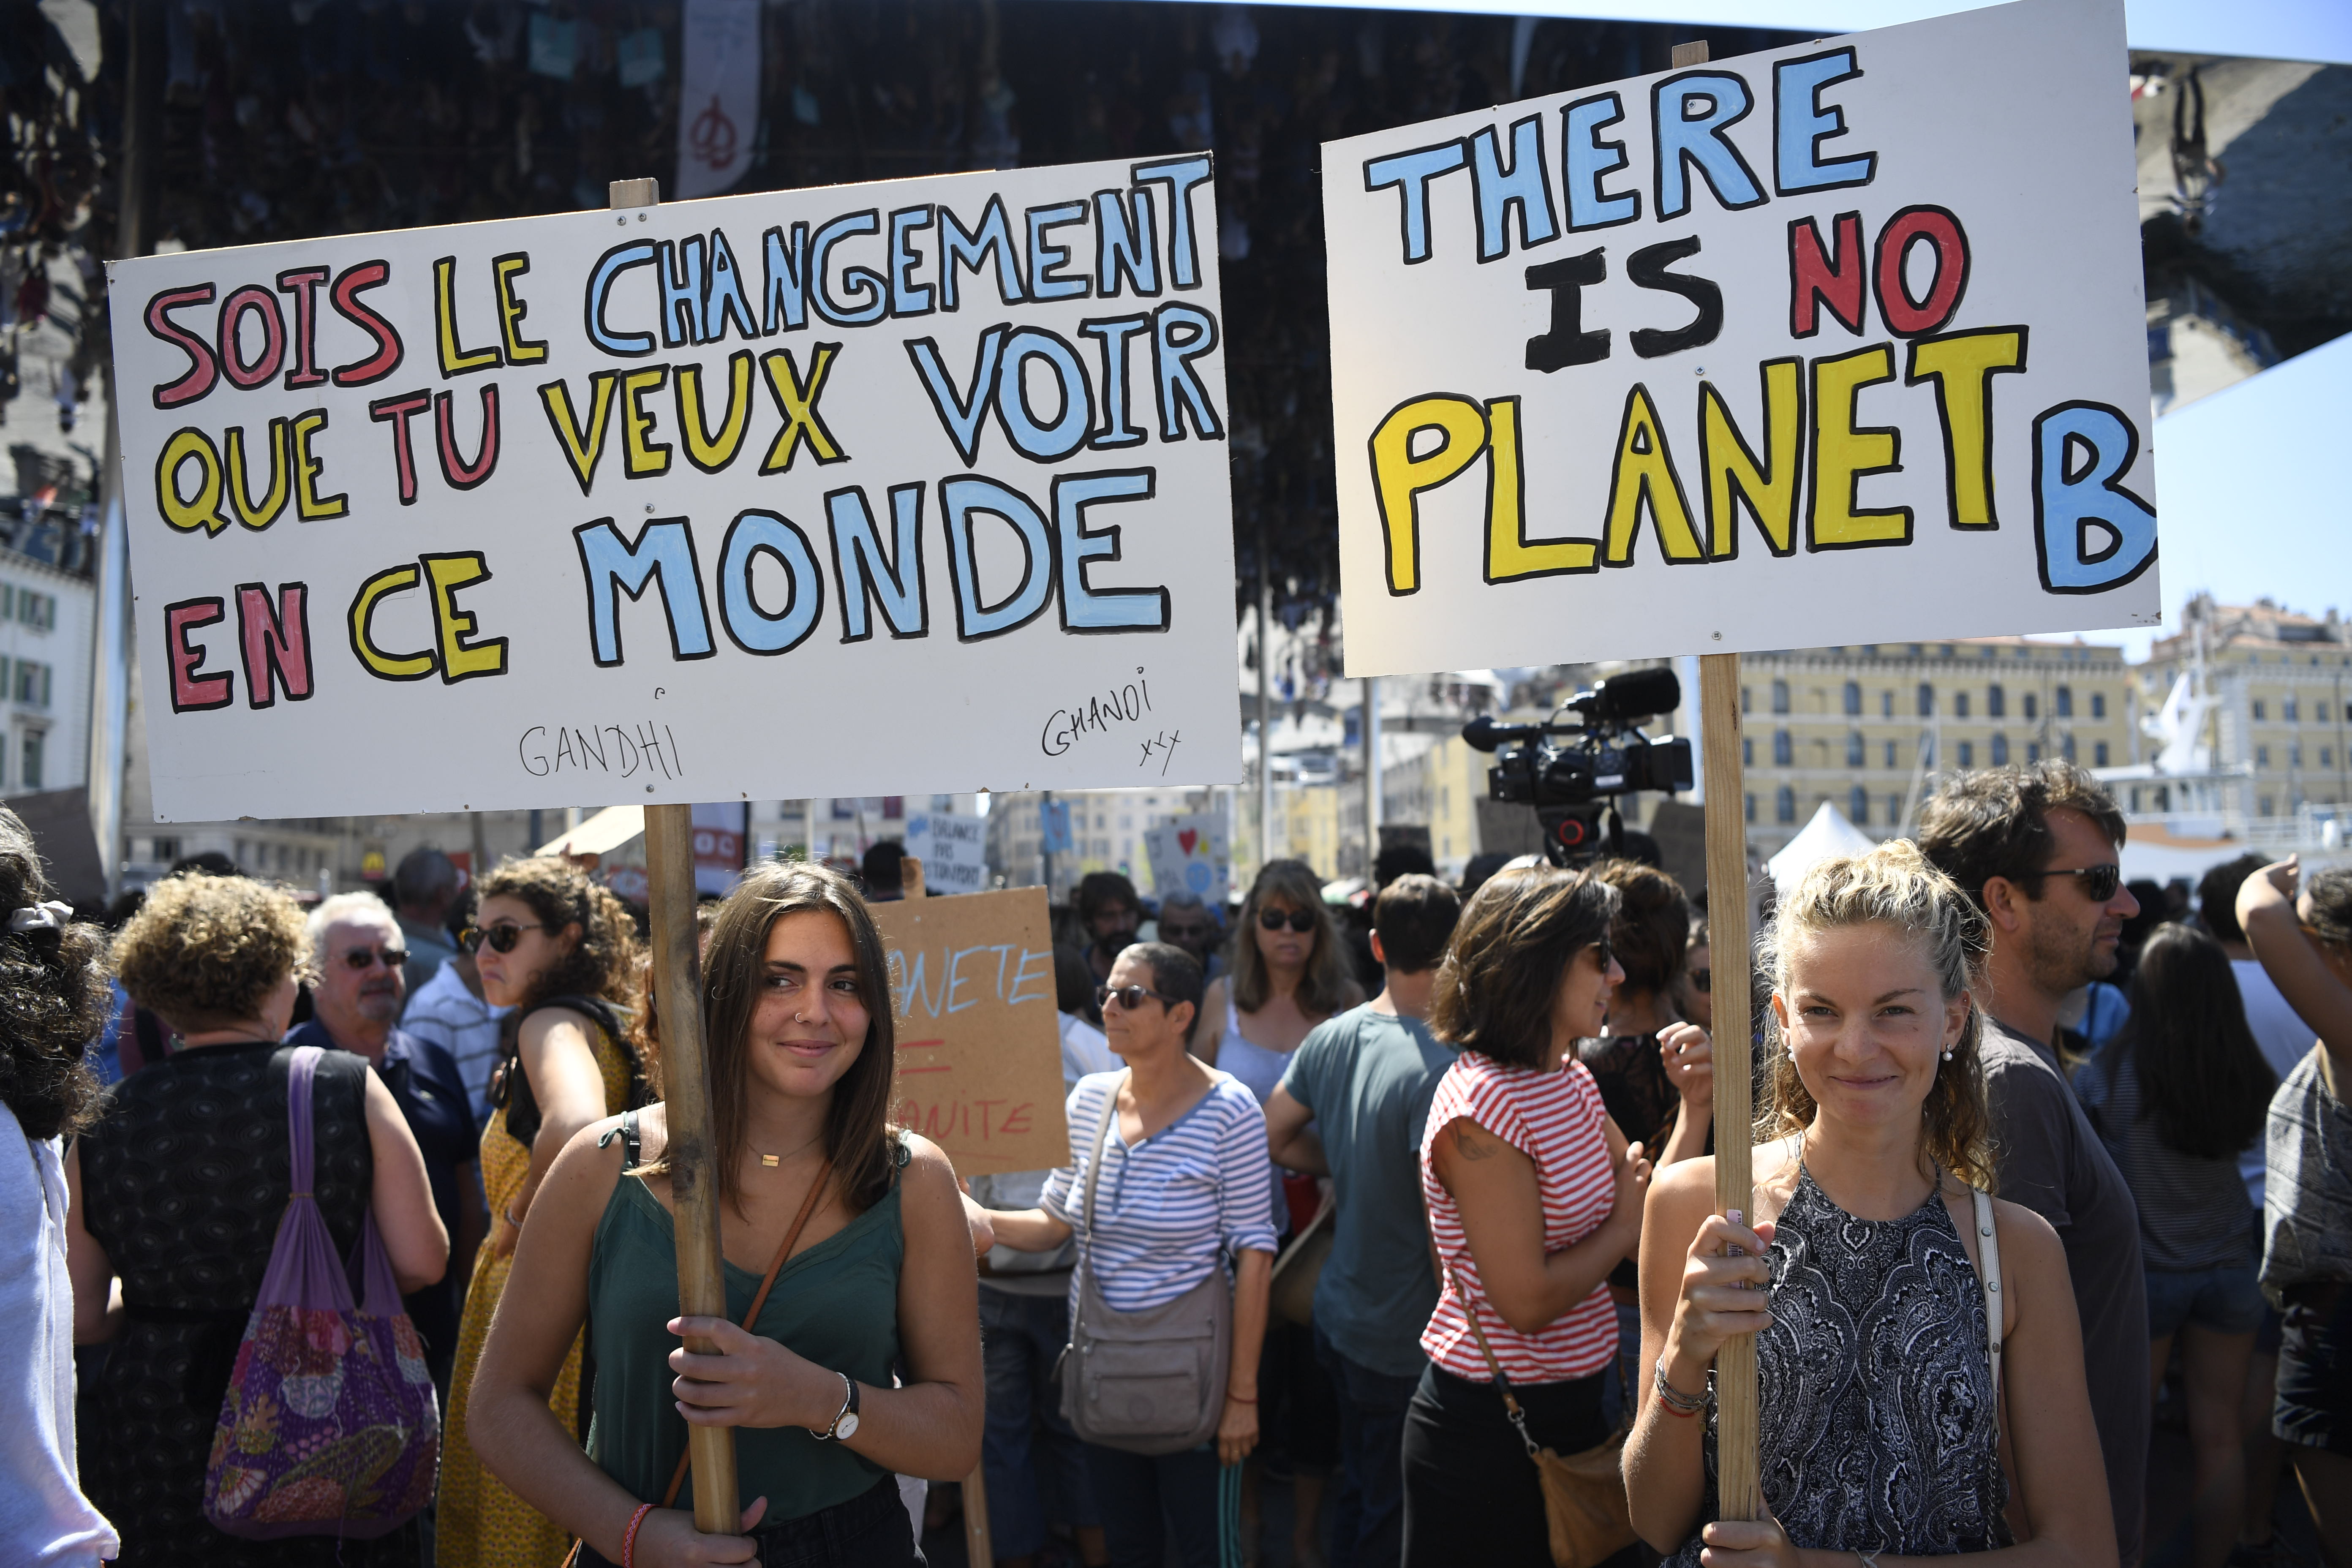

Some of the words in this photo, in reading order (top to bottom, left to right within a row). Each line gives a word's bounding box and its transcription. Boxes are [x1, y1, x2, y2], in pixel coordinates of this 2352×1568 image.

[1364, 45, 1878, 265] THERE
[144, 259, 404, 408] SOIS
[433, 252, 550, 378] LE
[585, 152, 1213, 357] CHANGEMENT
[1524, 234, 1724, 374] IS
[1787, 203, 1971, 340] NO
[155, 408, 348, 538] QUE
[370, 384, 501, 505] TU
[538, 340, 851, 498] VEUX
[903, 300, 1225, 468] VOIR
[1367, 324, 2030, 598] PLANET
[2032, 399, 2159, 596] B
[164, 582, 314, 714] EN
[348, 551, 509, 685] CE
[572, 467, 1171, 668] MONDE
[887, 943, 1054, 1018] ANETE
[897, 1089, 1036, 1140] ANITE
